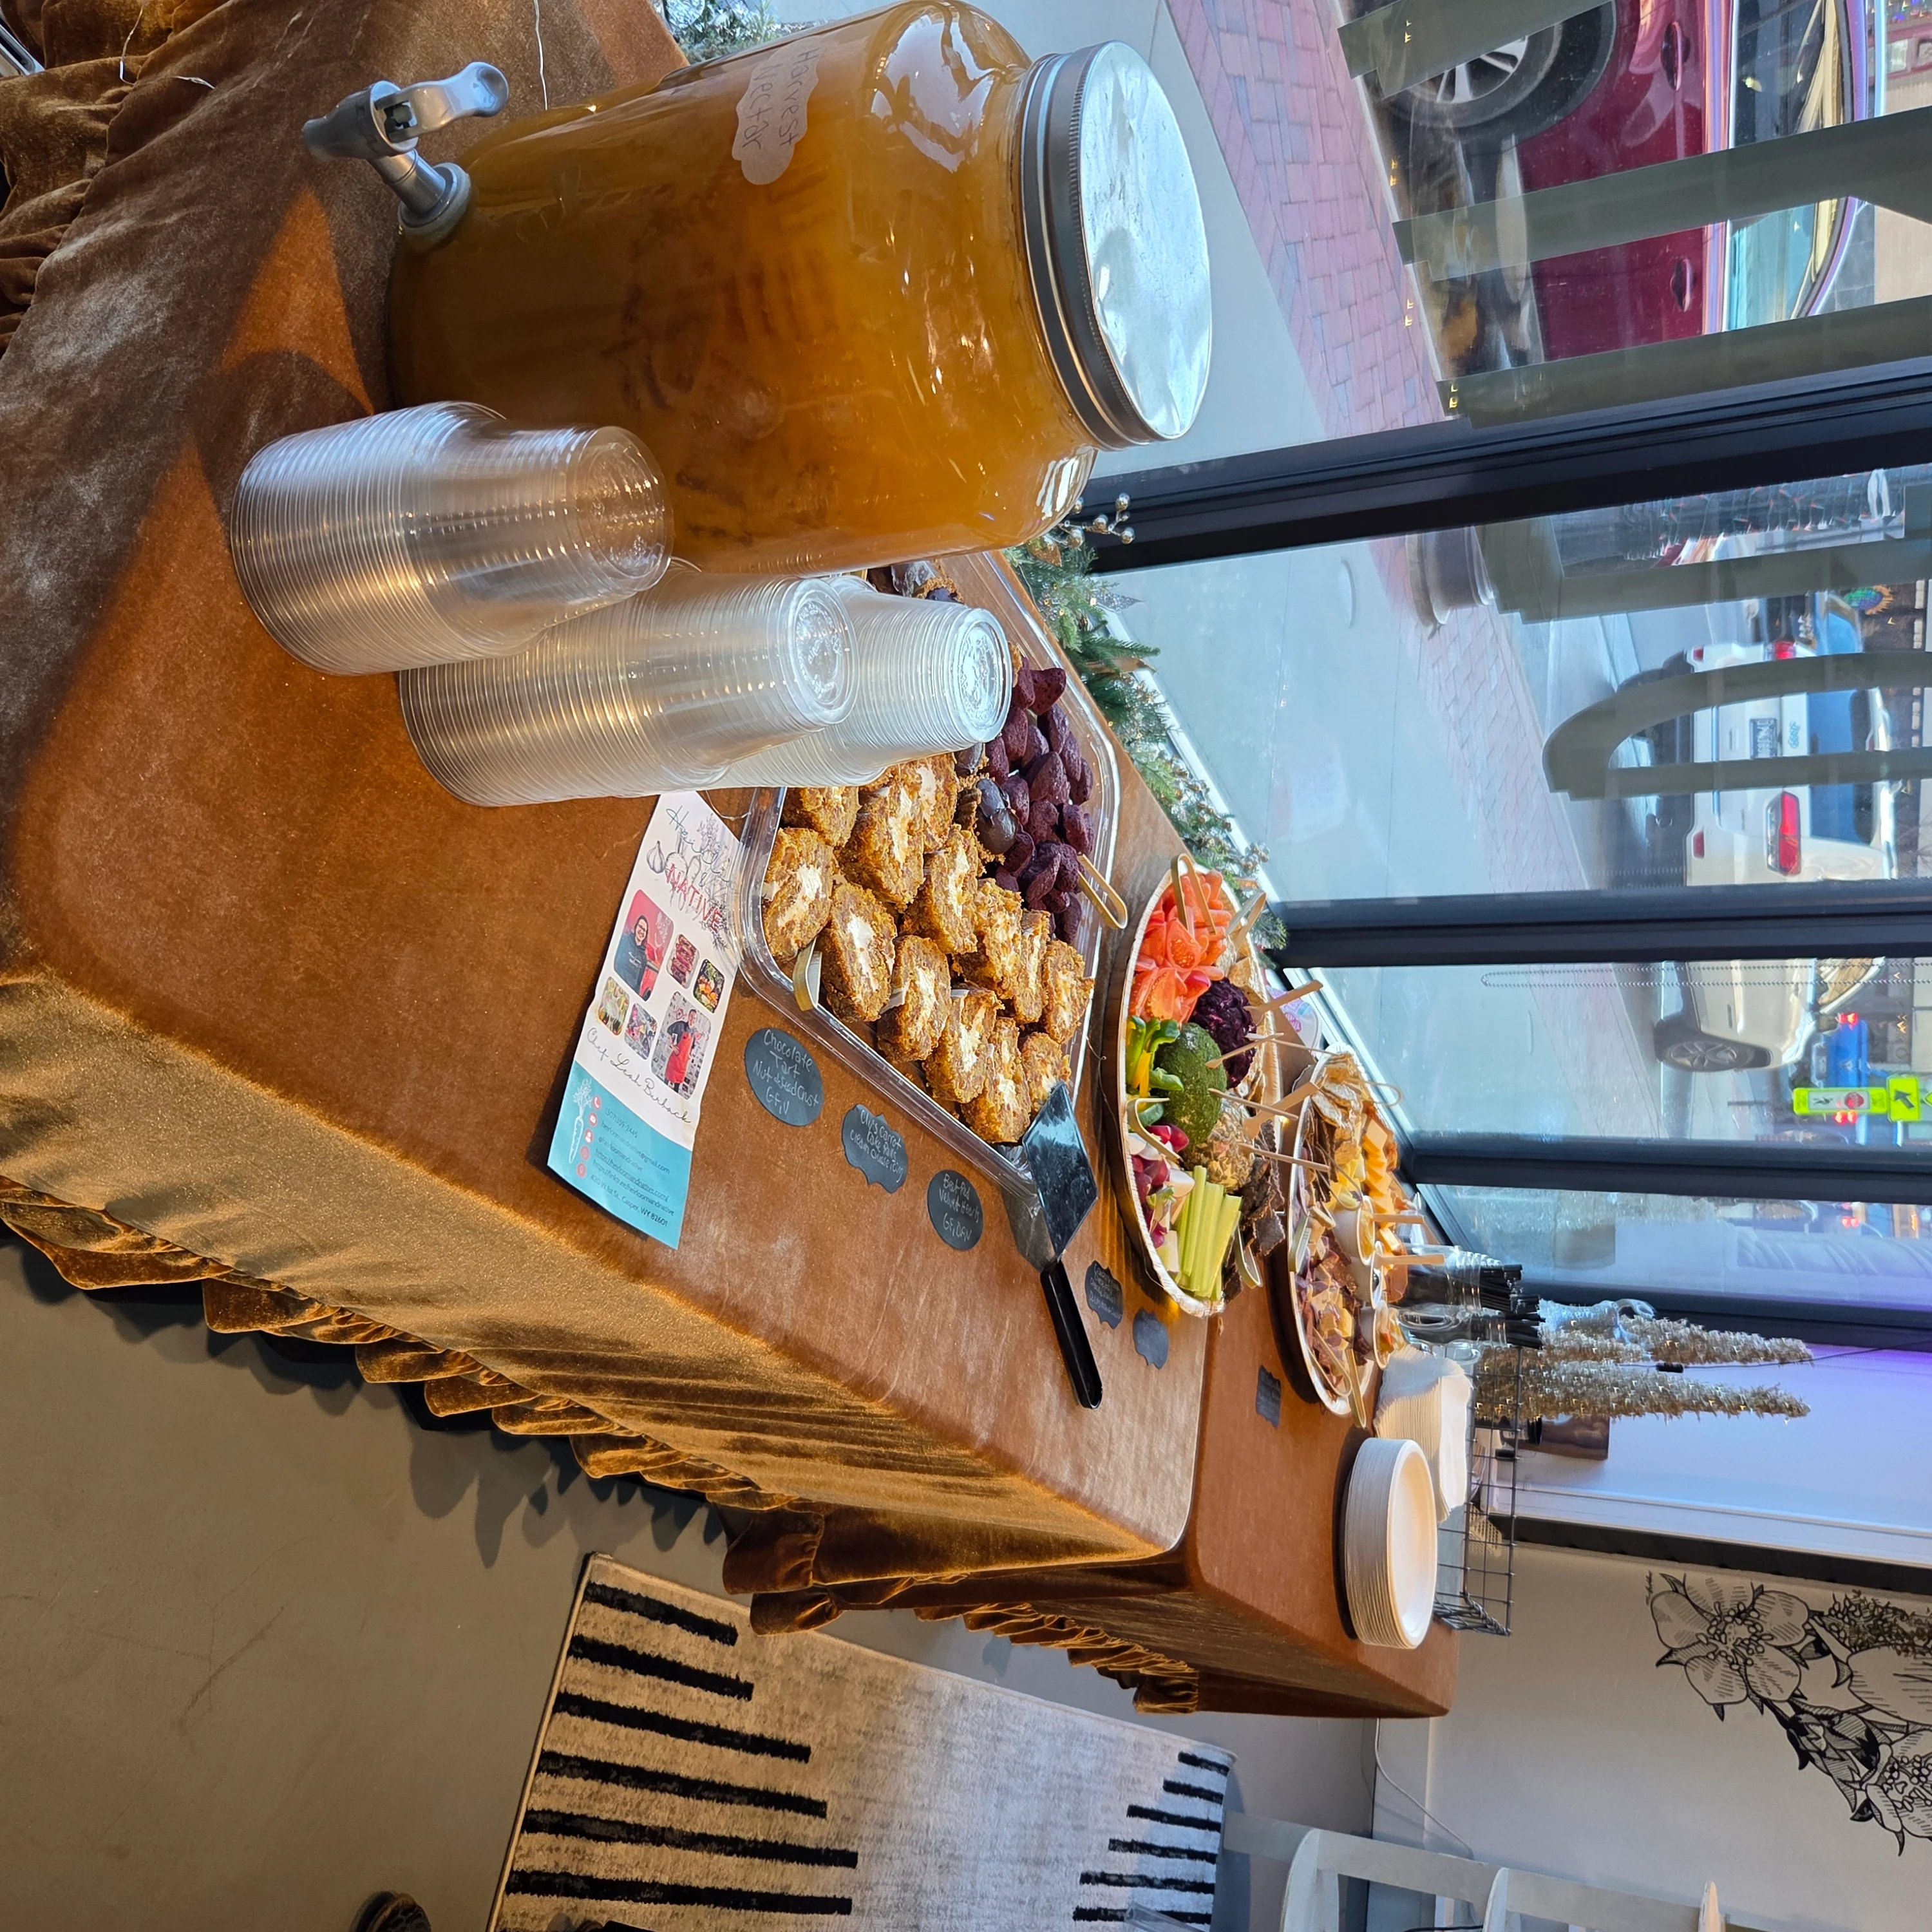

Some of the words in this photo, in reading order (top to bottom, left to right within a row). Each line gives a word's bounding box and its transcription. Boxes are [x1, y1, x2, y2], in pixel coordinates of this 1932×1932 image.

[743, 65, 782, 149] Nectar
[779, 48, 820, 146] Harvest
[666, 864, 724, 934] NATIVE
[587, 1027, 609, 1061] Chef
[610, 1053, 642, 1087] Leah
[764, 1029, 813, 1072] Chocolate
[770, 1050, 800, 1078] Tart
[879, 1126, 902, 1150] Carrot
[640, 1206, 650, 1218] WY
[651, 1212, 668, 1228] 82601
